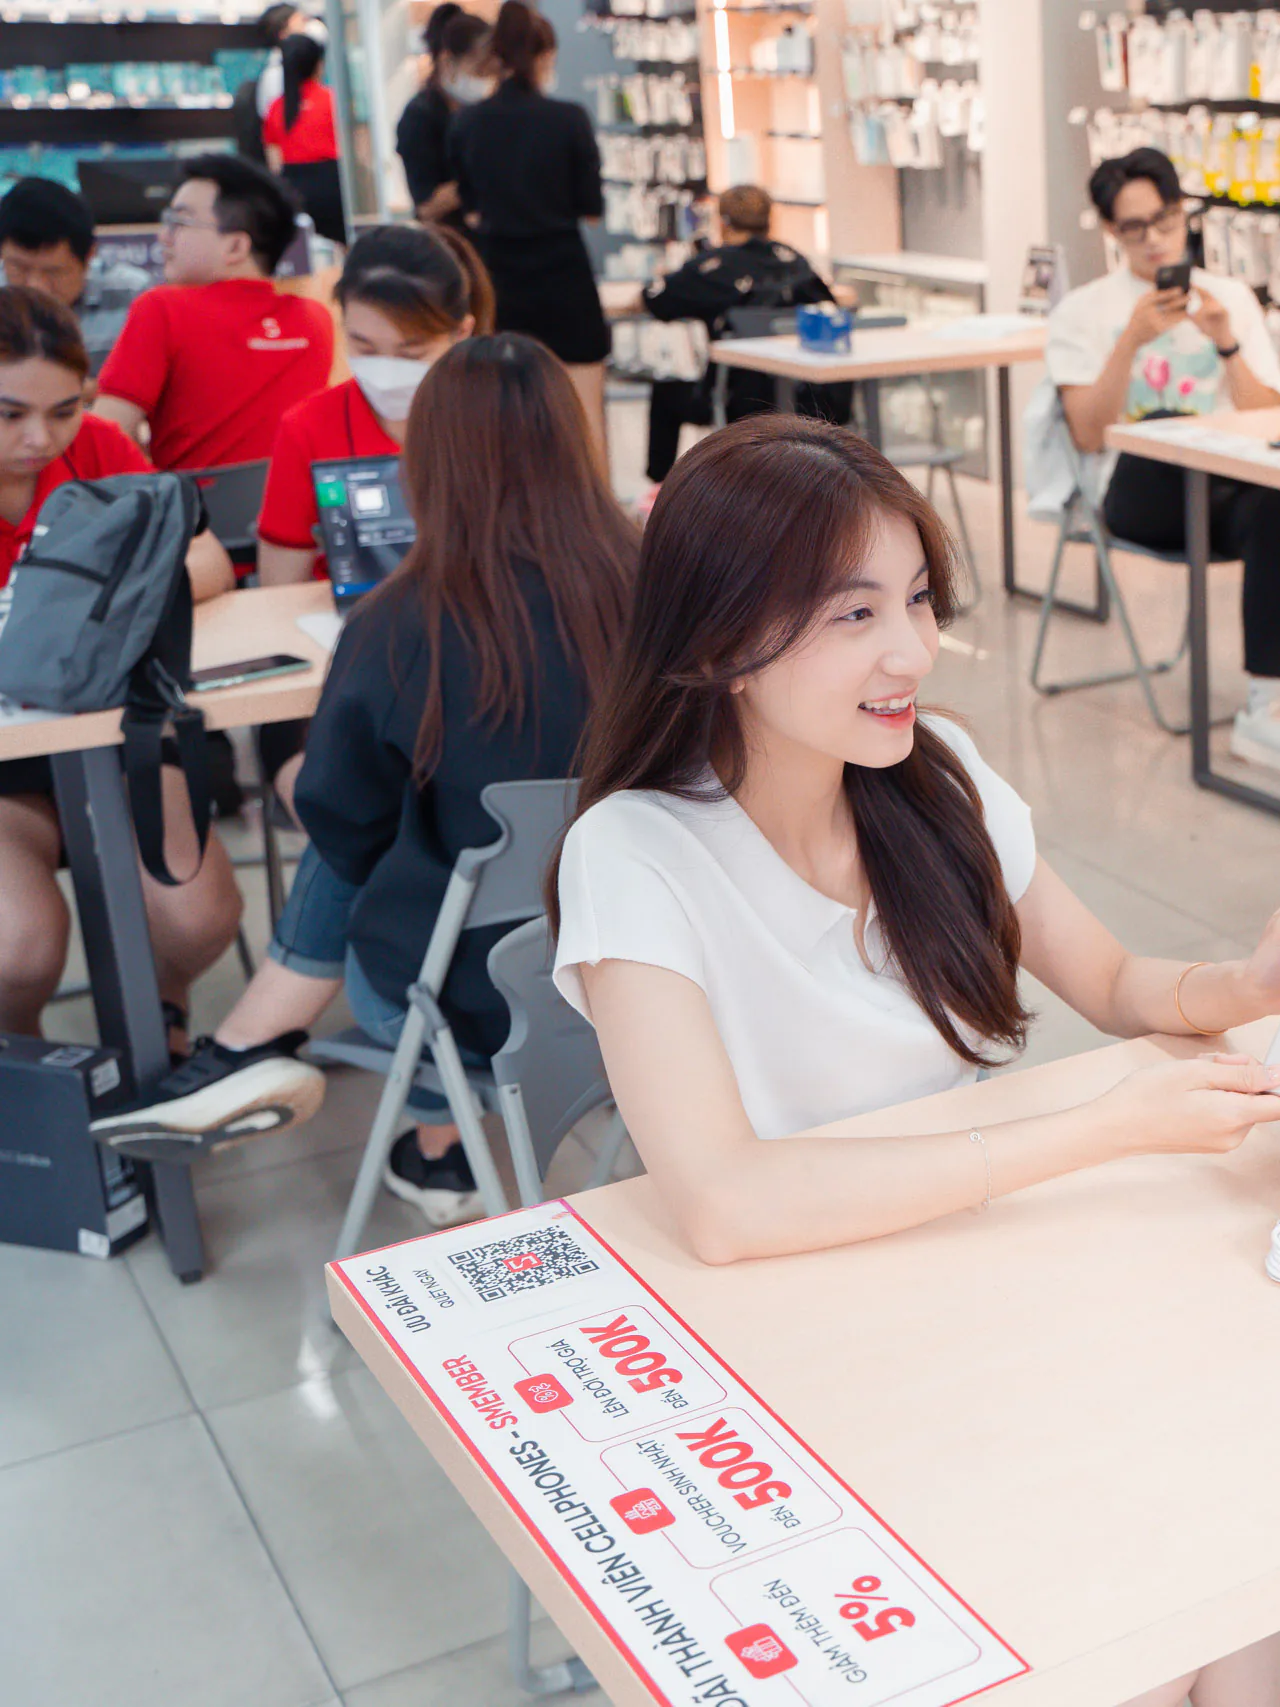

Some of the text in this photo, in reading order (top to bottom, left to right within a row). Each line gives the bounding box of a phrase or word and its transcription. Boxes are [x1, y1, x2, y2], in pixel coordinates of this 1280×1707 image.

[366, 1266, 431, 1333] ƯU ĐÃI KHÁC
[413, 1269, 454, 1308] QUÉT NGAY
[442, 1355, 518, 1429] SMEMBER
[546, 1339, 629, 1418] LÊN ĐỜI TRỢ GIÁ
[579, 1314, 688, 1408] ĐẾN 500K
[509, 1441, 615, 1553] CELLPHONES
[636, 1440, 747, 1553] VOUCHER SINH NHẬT
[675, 1417, 800, 1528] ĐẾN 500K
[597, 1553, 652, 1603] VIÊN
[835, 1576, 915, 1641] 5%
[635, 1600, 712, 1677] THÀNH
[765, 1579, 867, 1682] GIẢM THÊM ĐẾN
